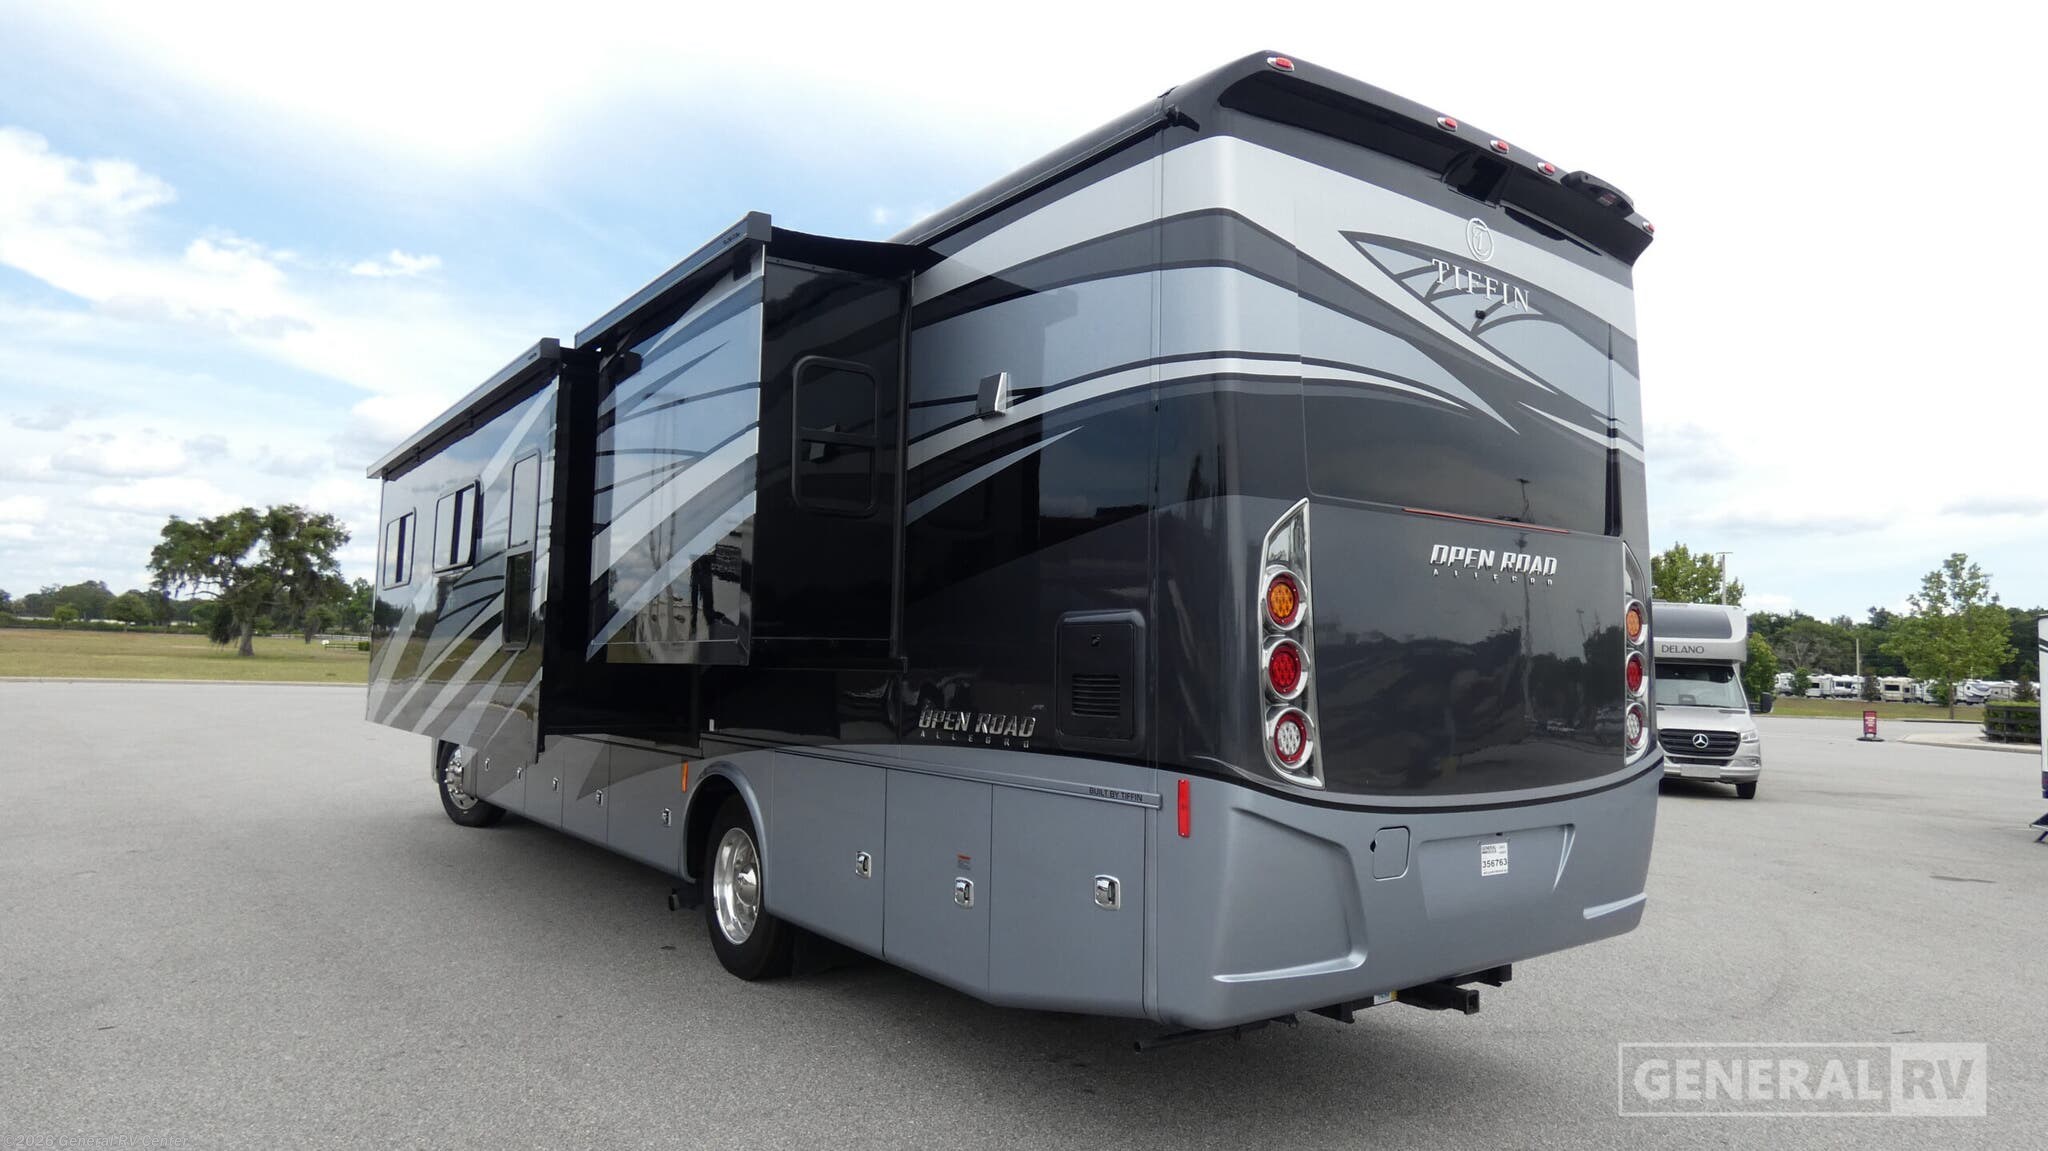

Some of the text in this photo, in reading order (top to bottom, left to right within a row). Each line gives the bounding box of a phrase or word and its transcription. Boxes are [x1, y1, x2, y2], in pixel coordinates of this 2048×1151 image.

[1432, 258, 1529, 312] TIFFIN
[1430, 544, 1558, 576] OPEN ROAD
[1661, 643, 1705, 654] DELANO
[918, 709, 1037, 738] OPEN ROAD
[920, 730, 1030, 749] ALLEGRO
[1089, 786, 1143, 802] BUILT BY TIFFIN
[1482, 858, 1508, 868] 356763
